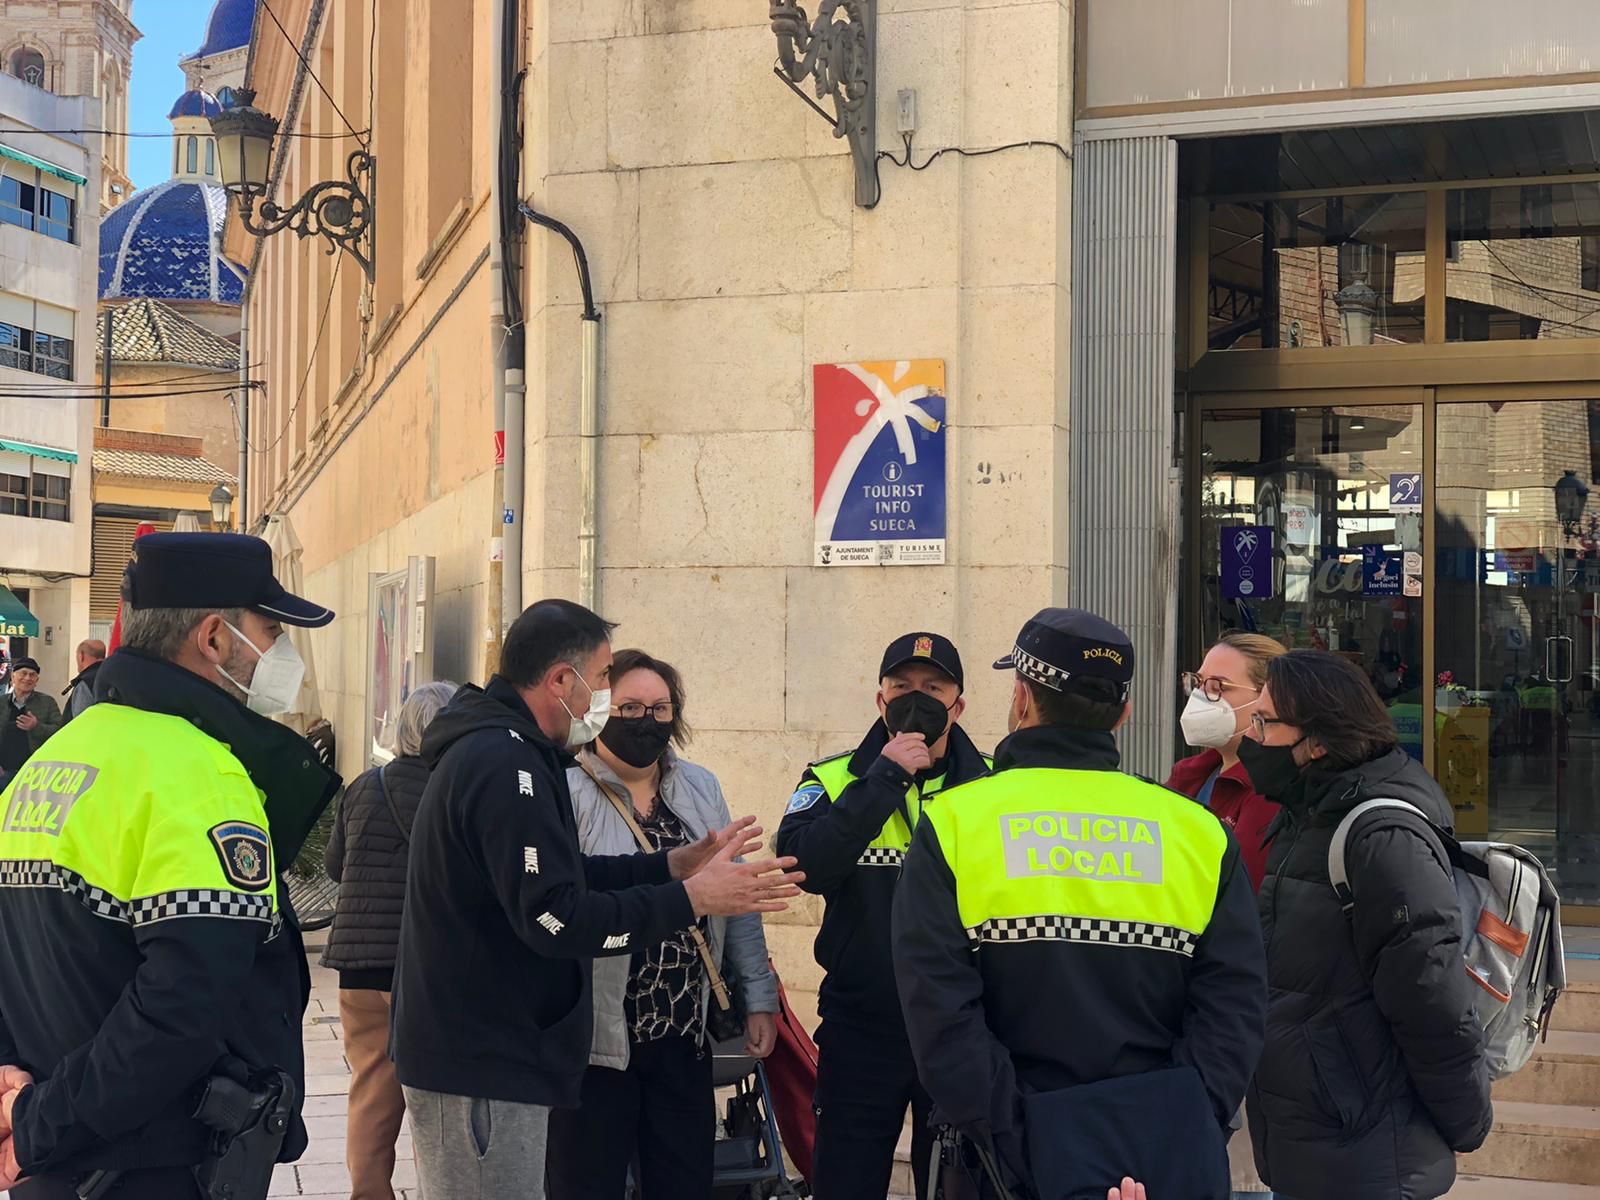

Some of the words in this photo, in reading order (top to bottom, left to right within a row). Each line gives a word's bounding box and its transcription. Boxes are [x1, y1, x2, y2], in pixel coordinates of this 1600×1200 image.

[862, 484, 924, 498] TOURIST
[875, 500, 911, 514] INFO
[869, 519, 916, 531] SUECA
[1082, 647, 1123, 665] POLICIA
[17, 766, 88, 794] POLICIA
[517, 769, 534, 797] NIKE
[1008, 815, 1155, 845] POLICIA
[524, 846, 539, 874] NIKE
[1027, 846, 1143, 878] LOCAL
[536, 911, 565, 936] NIKE
[602, 932, 631, 949] NIKE
